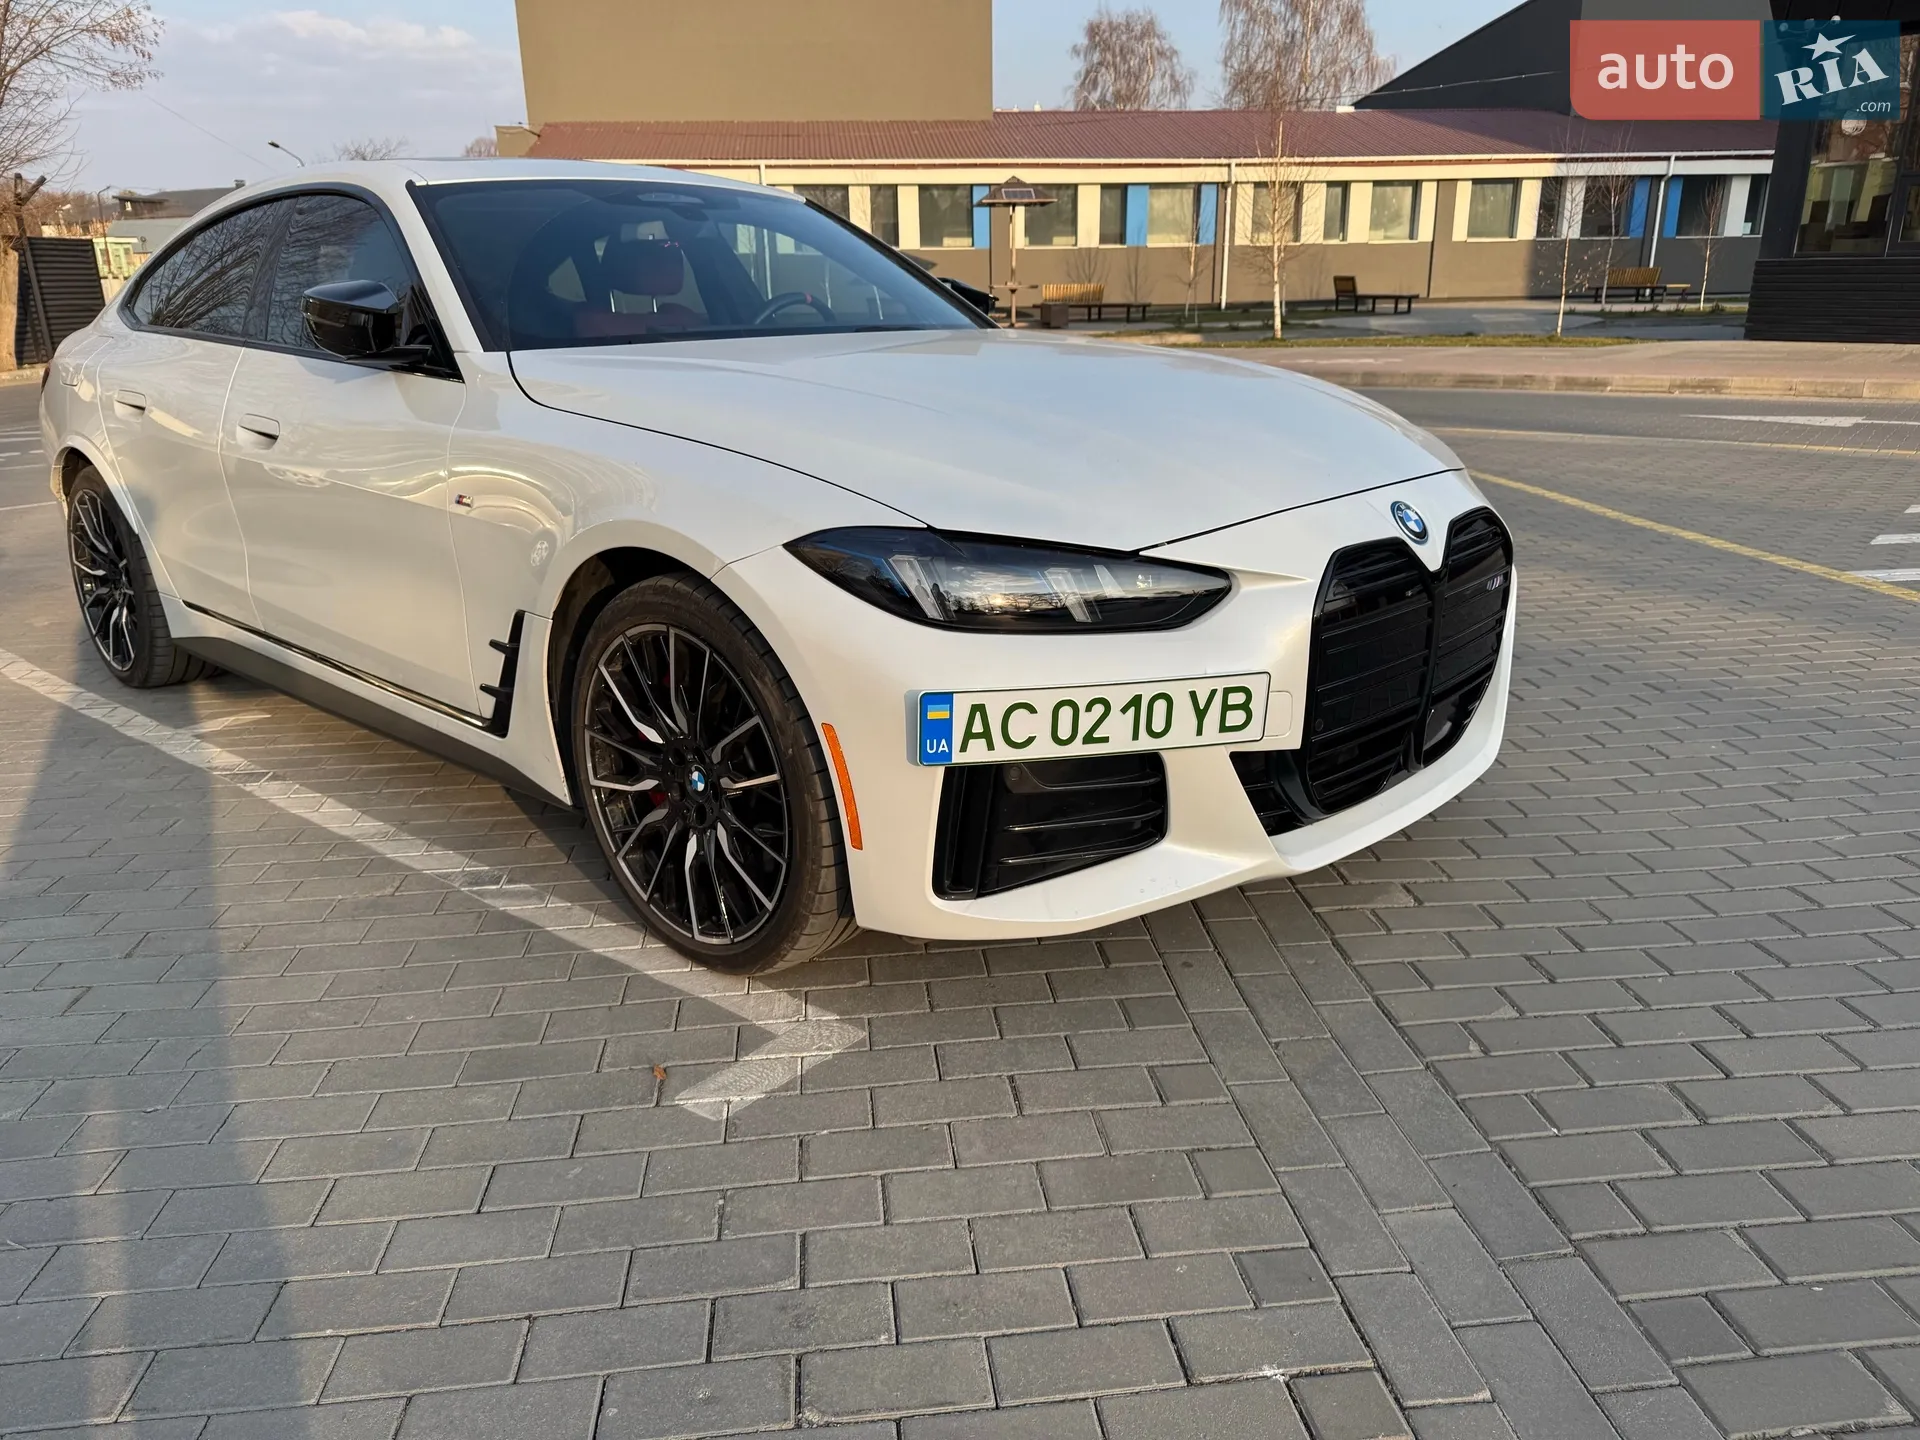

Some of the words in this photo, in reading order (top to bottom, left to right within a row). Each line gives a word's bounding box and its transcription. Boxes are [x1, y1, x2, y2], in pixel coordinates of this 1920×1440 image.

[958, 701, 1039, 753] AC
[1050, 691, 1174, 747] 0210
[1188, 685, 1254, 737] YB
[926, 738, 949, 754] UA
